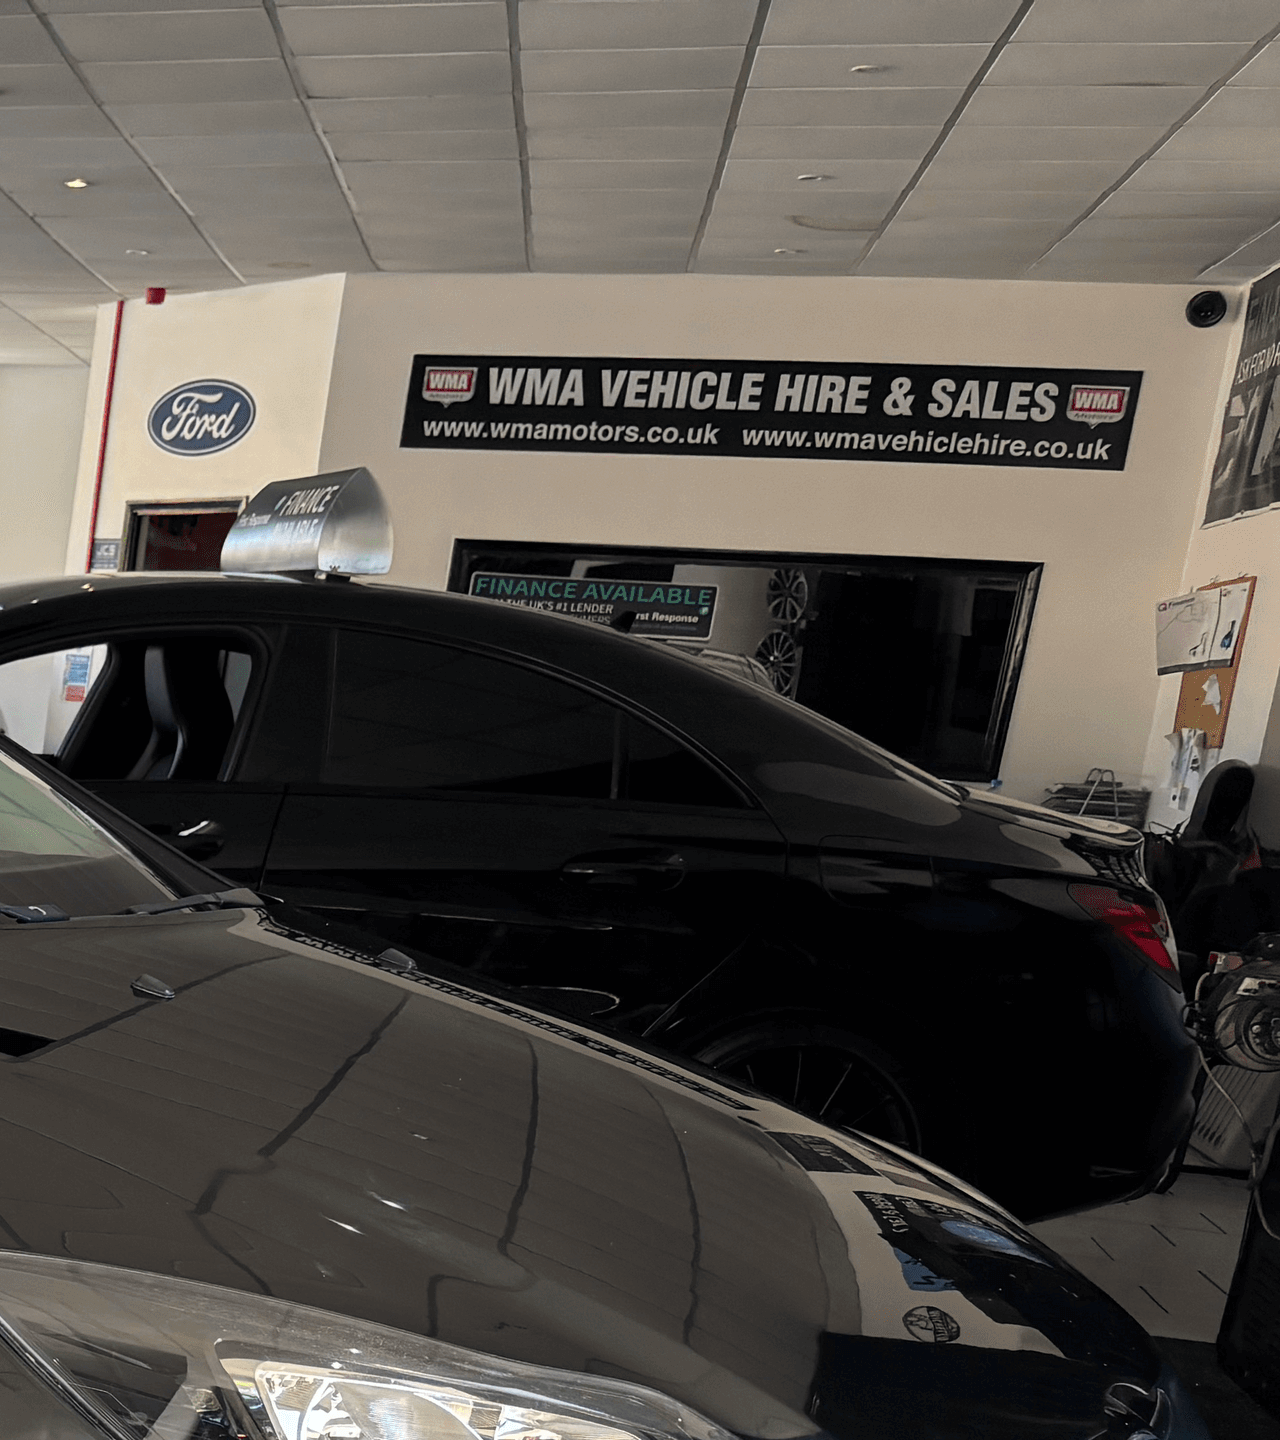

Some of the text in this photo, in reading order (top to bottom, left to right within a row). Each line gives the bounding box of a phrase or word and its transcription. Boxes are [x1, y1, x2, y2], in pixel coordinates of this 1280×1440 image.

[429, 373, 468, 389] WMA
[489, 366, 1059, 423] WMA VEHICLE HIRE & SALES
[1075, 391, 1118, 410] WMA
[161, 392, 240, 441] Ford
[423, 419, 1112, 461] www.wmamotors.co.uk www.wmavehiclehire.co.uk
[475, 577, 713, 606] FINANCE AVAILABLE
[529, 600, 554, 611] UK'S
[570, 602, 614, 614] LENDER
[651, 611, 699, 623] Response
